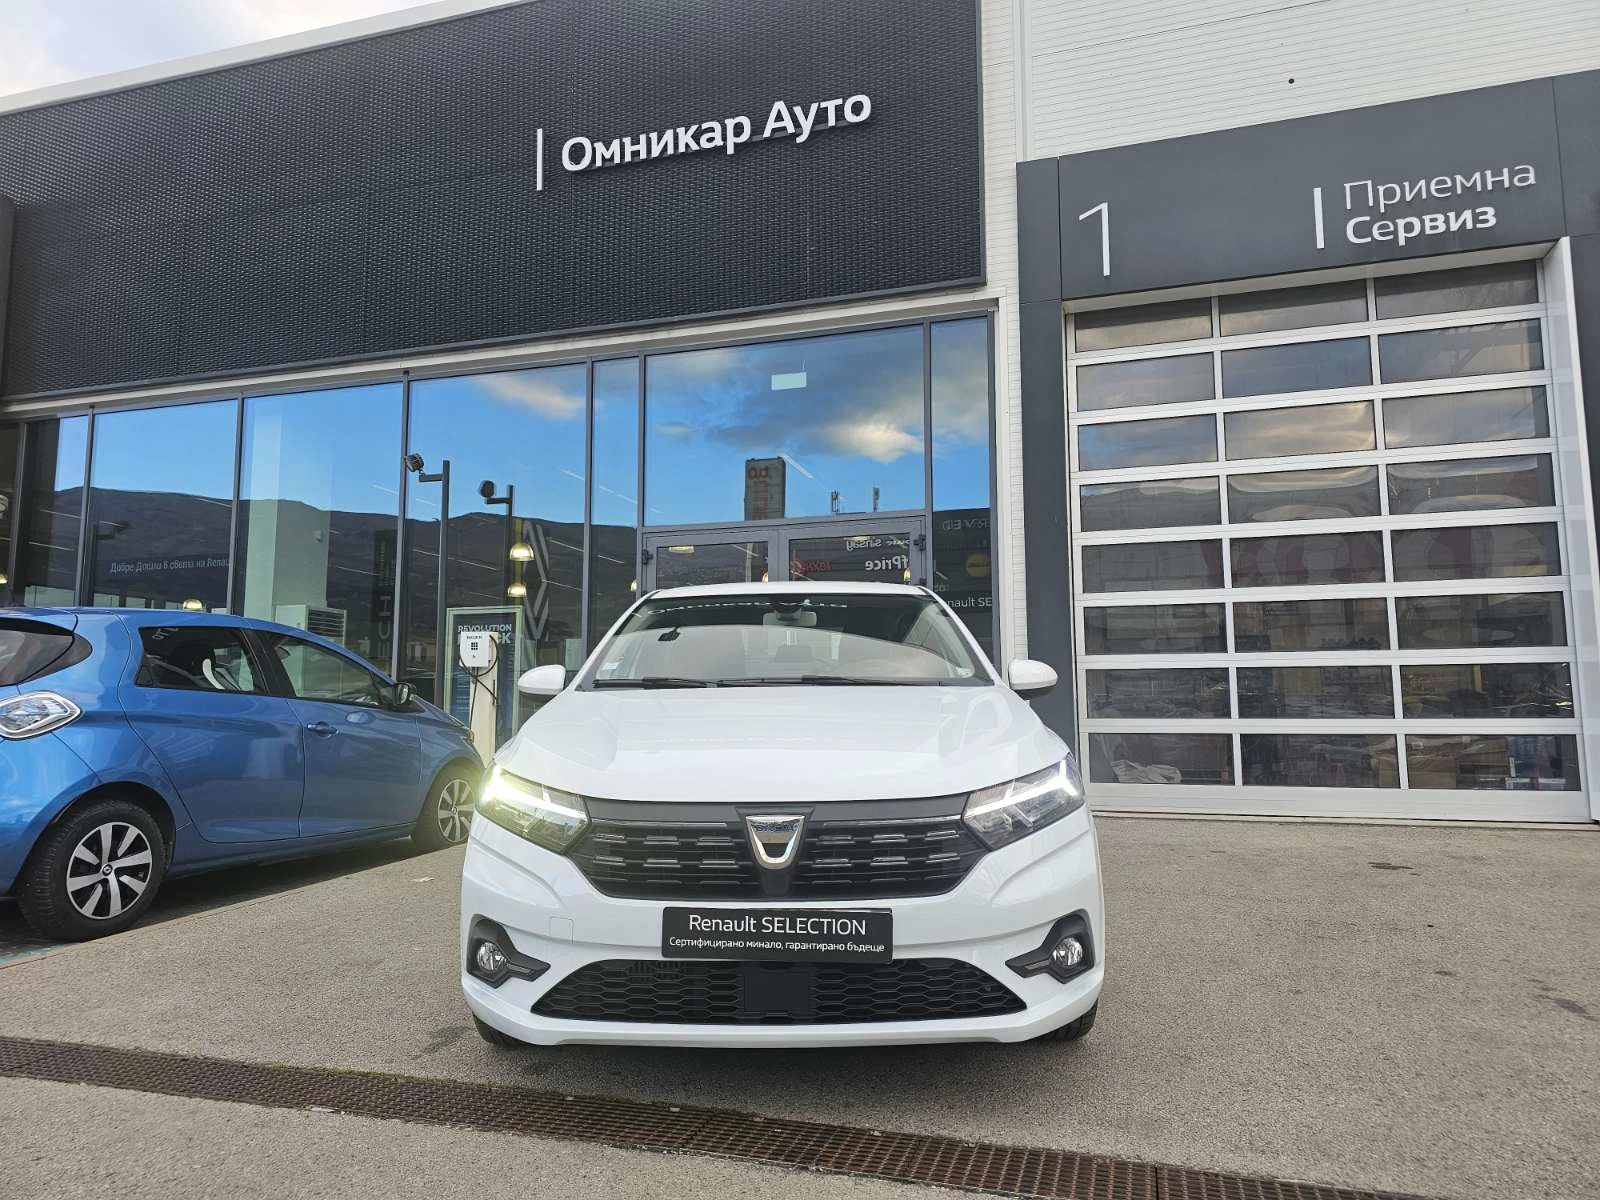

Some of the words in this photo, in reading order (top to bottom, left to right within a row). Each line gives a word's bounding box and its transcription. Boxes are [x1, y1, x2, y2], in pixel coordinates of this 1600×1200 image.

[561, 115, 751, 172] Омникар
[763, 94, 872, 144] Ауто
[1344, 164, 1537, 213] Приемна
[1078, 202, 1111, 277] 1
[1346, 206, 1498, 246] Сервиз
[947, 597, 976, 608] nault
[978, 597, 992, 607] SE
[457, 624, 512, 633] REVOLUTION
[689, 914, 757, 932] Renault
[761, 917, 867, 936] SELECTION
[669, 936, 745, 949] Сертифицирано
[747, 939, 784, 951] минало,
[785, 941, 845, 952] гарантирано
[847, 941, 885, 953] бъдеще
